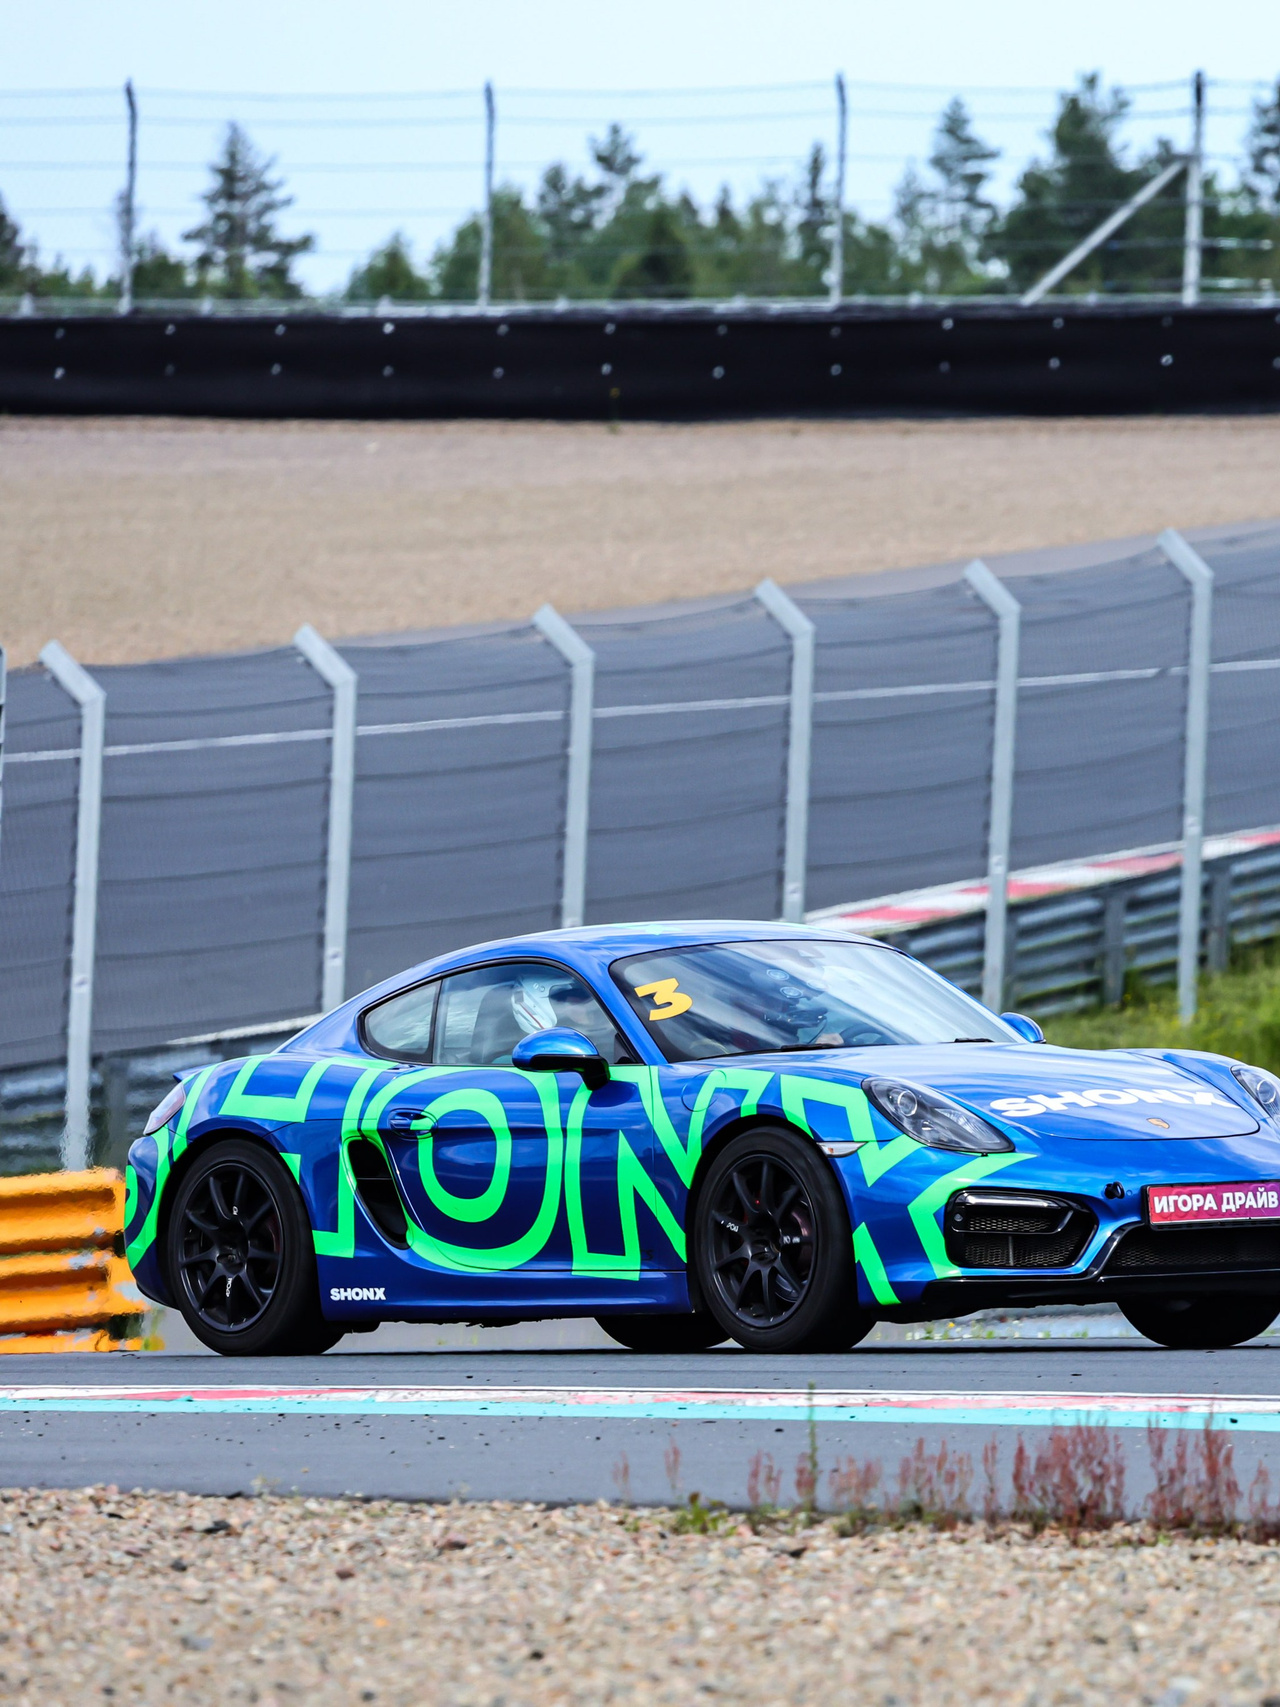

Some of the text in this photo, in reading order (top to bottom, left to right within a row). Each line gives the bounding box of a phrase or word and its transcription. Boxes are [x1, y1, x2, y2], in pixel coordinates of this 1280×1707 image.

[634, 977, 693, 1021] 3
[990, 1088, 1241, 1117] SHONX
[1153, 1186, 1279, 1214] ИГОРА ДРАЙВ
[330, 1287, 387, 1301] SHONX
